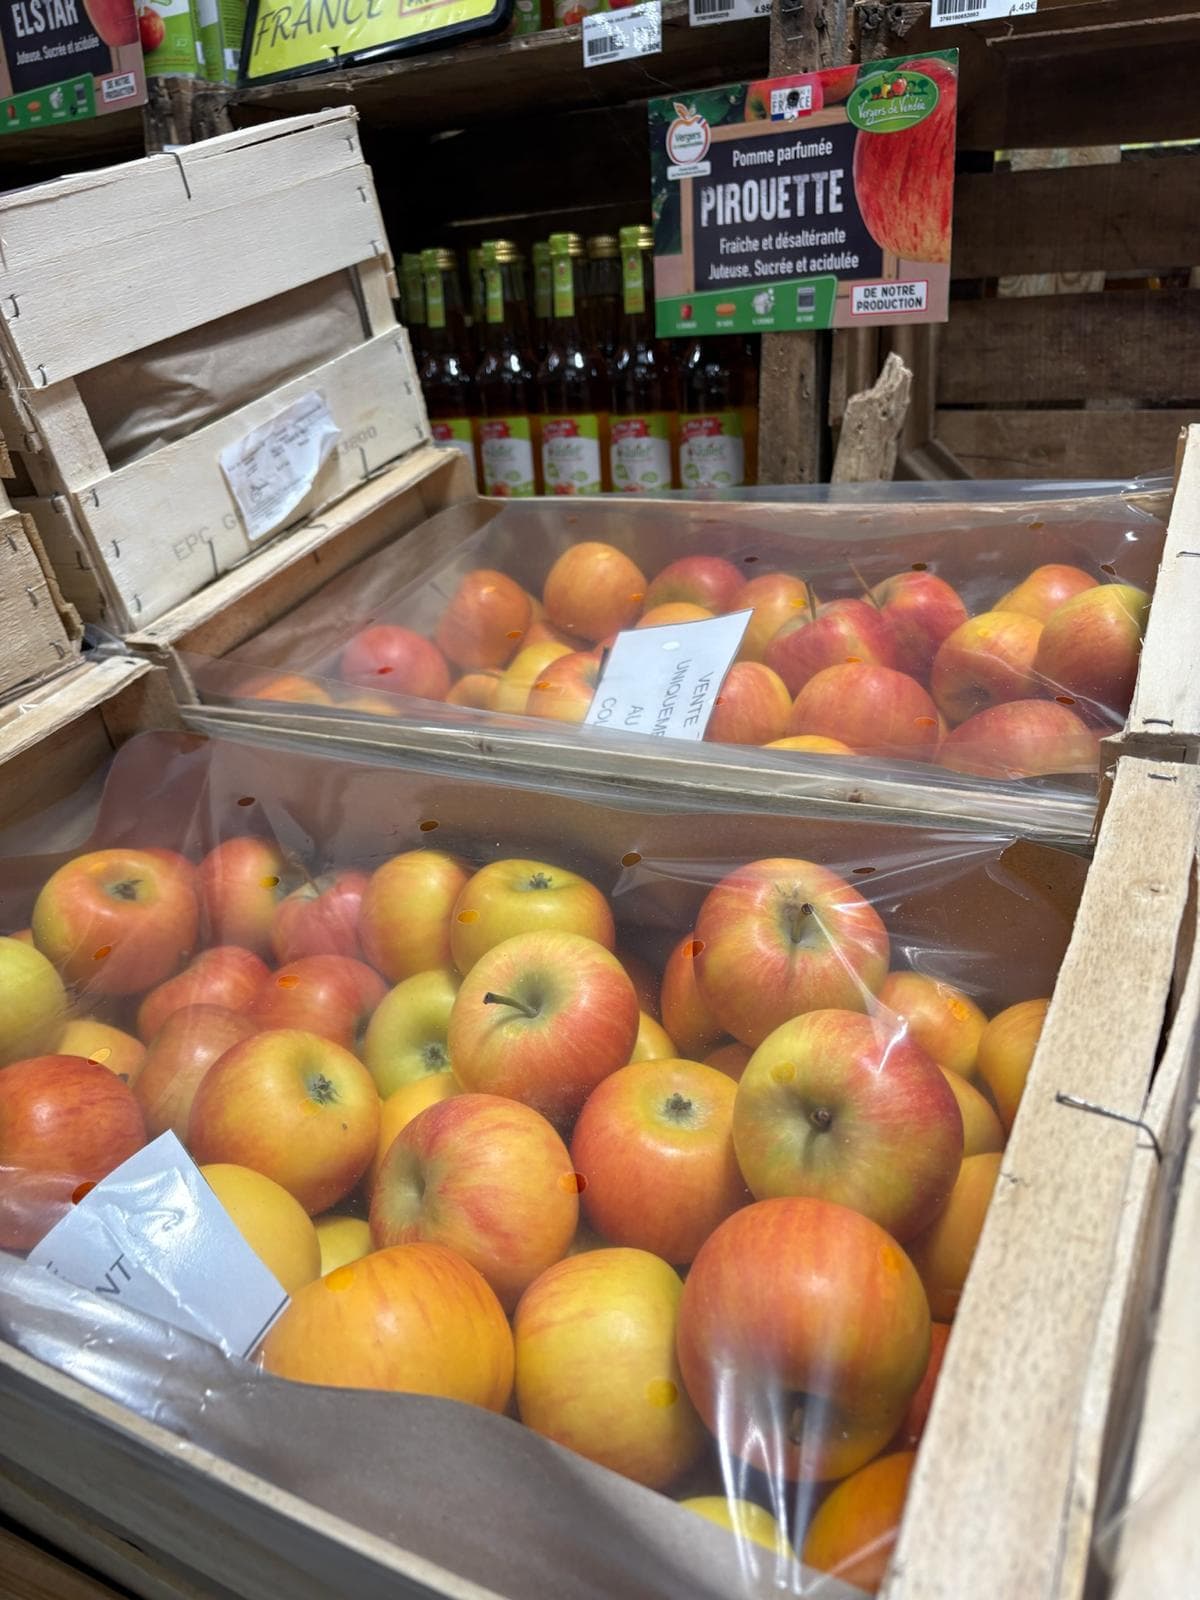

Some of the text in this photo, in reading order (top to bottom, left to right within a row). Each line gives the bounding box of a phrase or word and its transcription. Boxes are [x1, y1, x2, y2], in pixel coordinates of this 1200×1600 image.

[11, 0, 79, 38] ELSTAR
[732, 138, 833, 167] Pomme parfumée
[701, 169, 844, 227] PIROUETTE
[720, 227, 846, 254] Fraîche et désaltérante
[754, 257, 793, 276] Sucrée
[796, 257, 807, 272] et
[810, 251, 859, 272] acidulée
[856, 297, 923, 311] PRODUCTION
[864, 285, 915, 298] DE NOTRE
[683, 672, 714, 729] VENTE
[624, 705, 644, 727] AU
